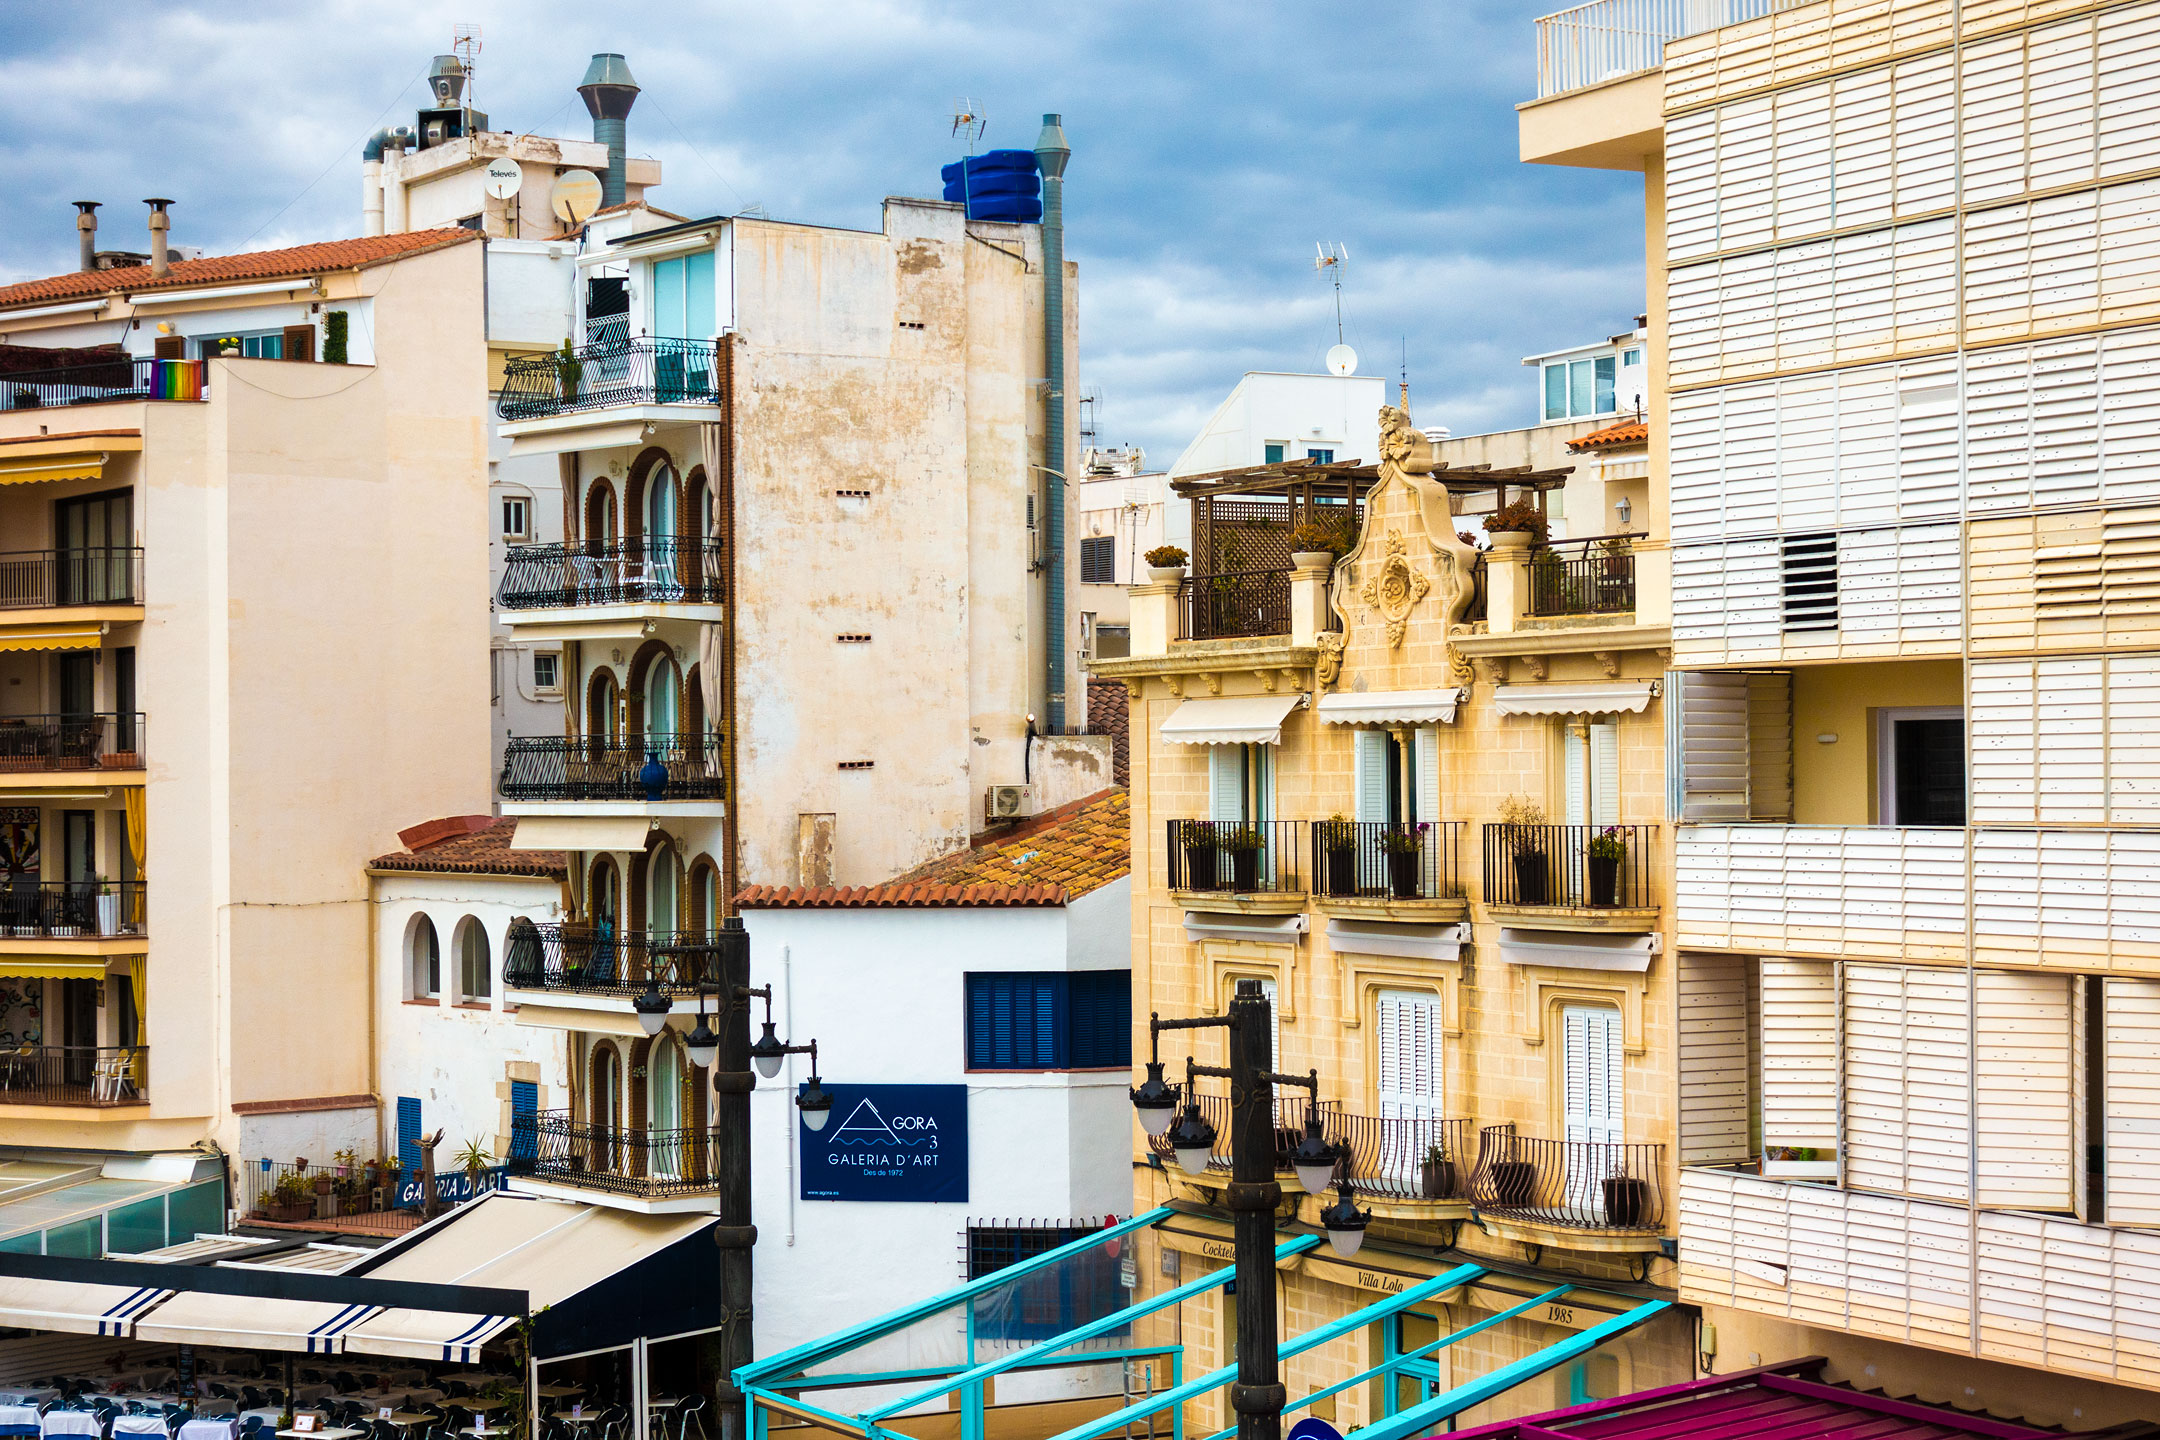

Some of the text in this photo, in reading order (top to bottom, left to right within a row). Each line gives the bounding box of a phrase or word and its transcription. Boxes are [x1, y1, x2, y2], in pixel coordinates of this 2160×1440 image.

[929, 1135, 939, 1150] 3
[828, 1153, 939, 1166] GALERIA D'ART
[888, 1169, 904, 1177] 1972
[403, 1178, 458, 1202] GARIA
[1358, 1271, 1404, 1293] Villa Lola
[1547, 1306, 1574, 1325] 1985
